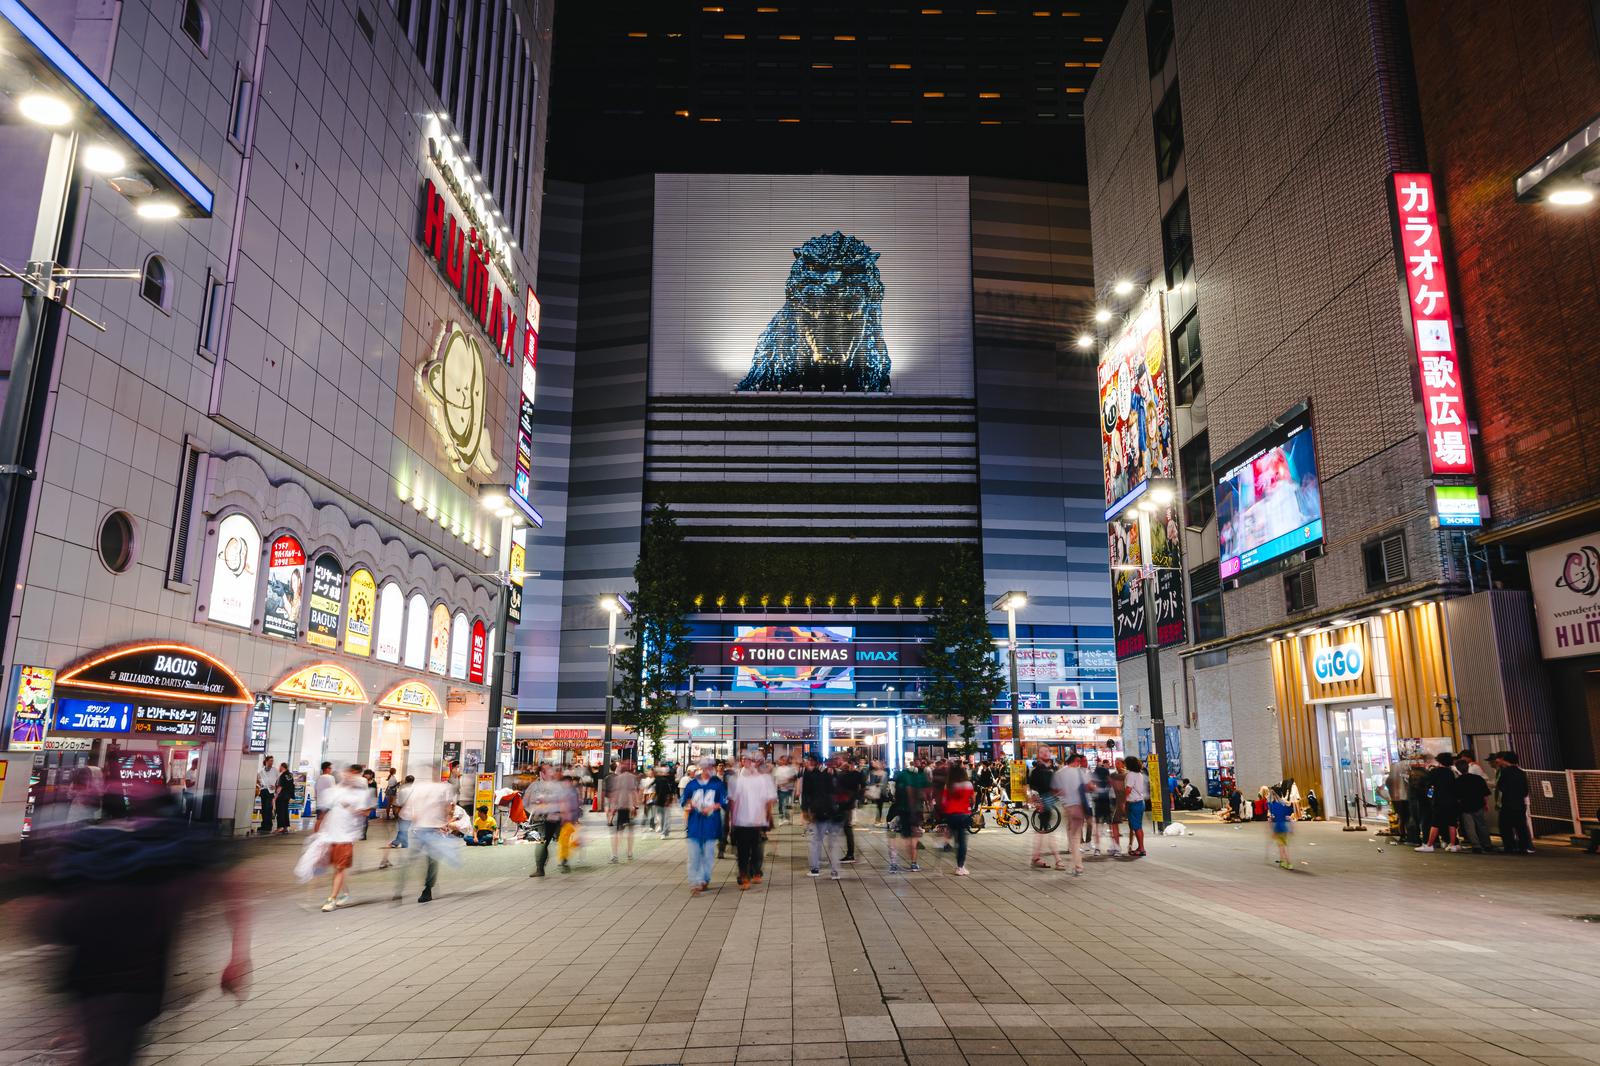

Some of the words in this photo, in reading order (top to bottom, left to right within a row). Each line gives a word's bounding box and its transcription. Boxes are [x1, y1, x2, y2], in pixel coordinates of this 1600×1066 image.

[1400, 182, 1444, 316] カラオケ
[1421, 355, 1466, 467] 歌広場
[315, 565, 342, 586] ビリヤード
[314, 579, 329, 596] ダーツ
[311, 609, 337, 629] BAGUS
[749, 648, 785, 660] TOHO
[788, 648, 848, 661] CINEMAS
[855, 651, 898, 661] IMAX
[154, 654, 198, 678] BAGUS
[118, 672, 154, 686] BILLIARDS
[209, 683, 224, 694] GOLF
[60, 715, 69, 724] 4F
[137, 705, 146, 718] 5F
[202, 711, 217, 726] 24H
[200, 723, 216, 735] OPEN
[554, 729, 588, 739] MARUHAN
